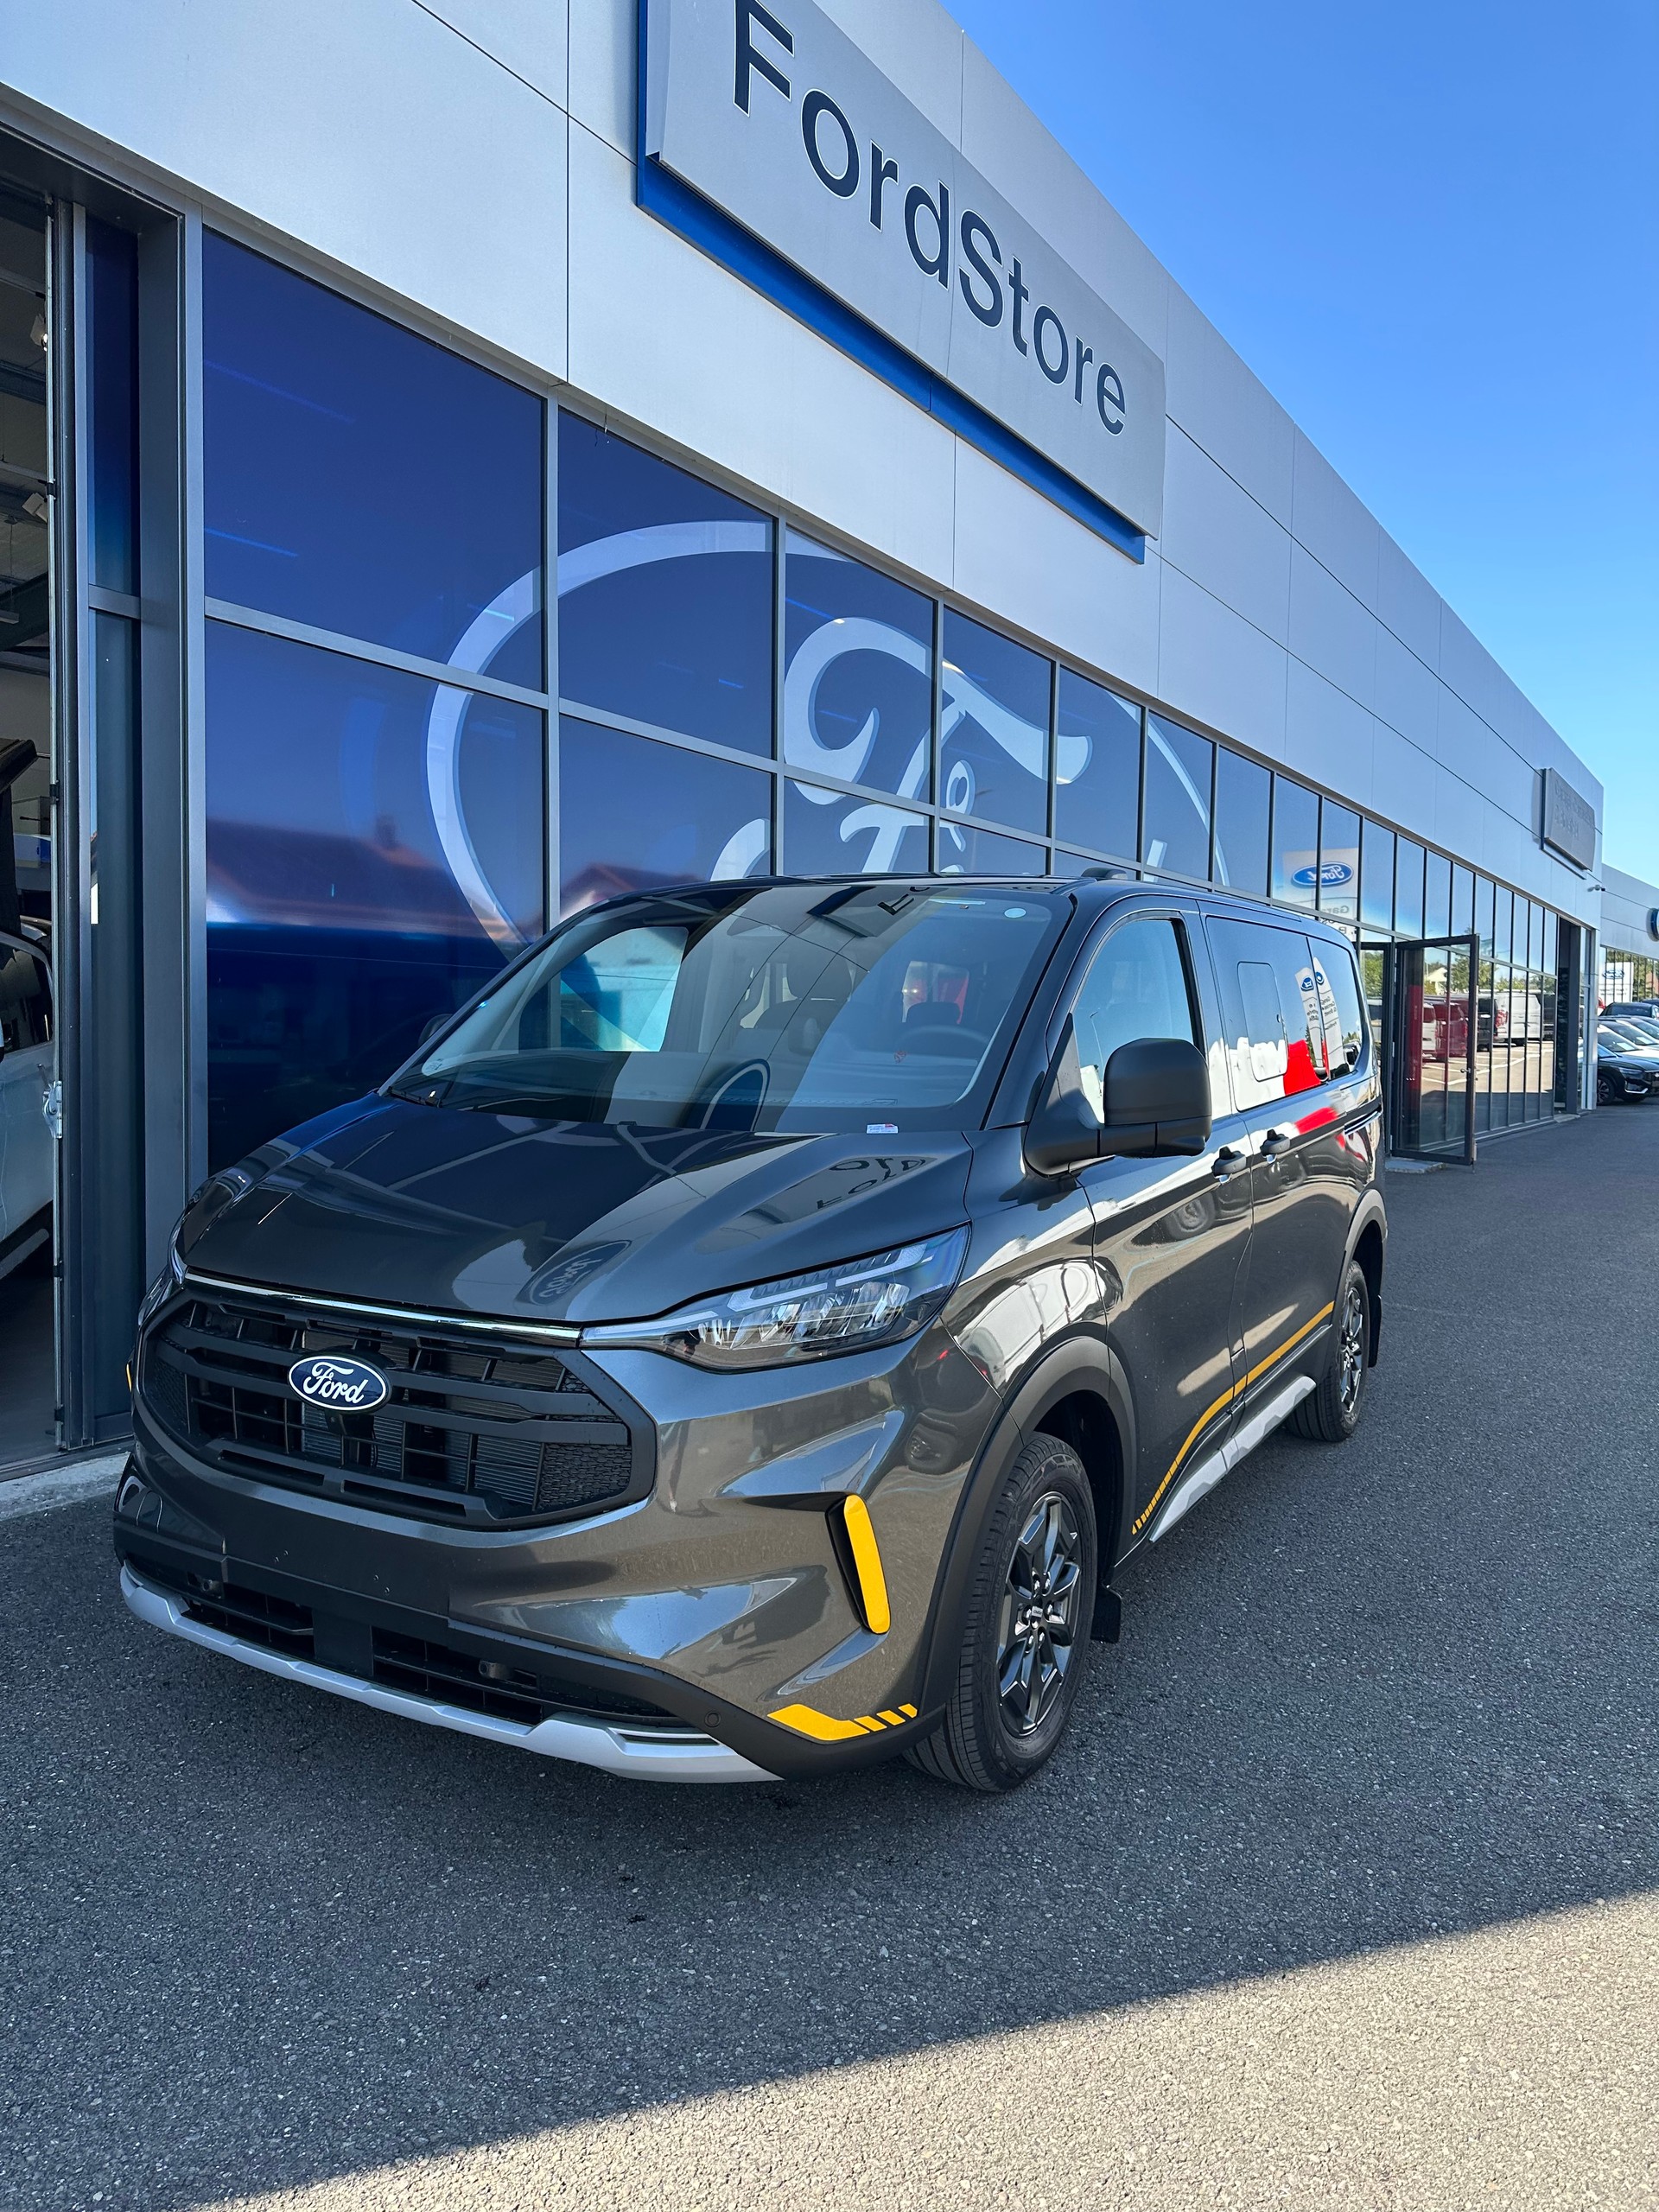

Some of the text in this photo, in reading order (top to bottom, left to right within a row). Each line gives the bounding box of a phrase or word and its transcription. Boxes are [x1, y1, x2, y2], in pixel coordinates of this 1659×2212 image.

[734, 0, 1126, 435] FordStore
[302, 1361, 369, 1404] Ford
[1001, 1539, 1013, 1562] Eco
